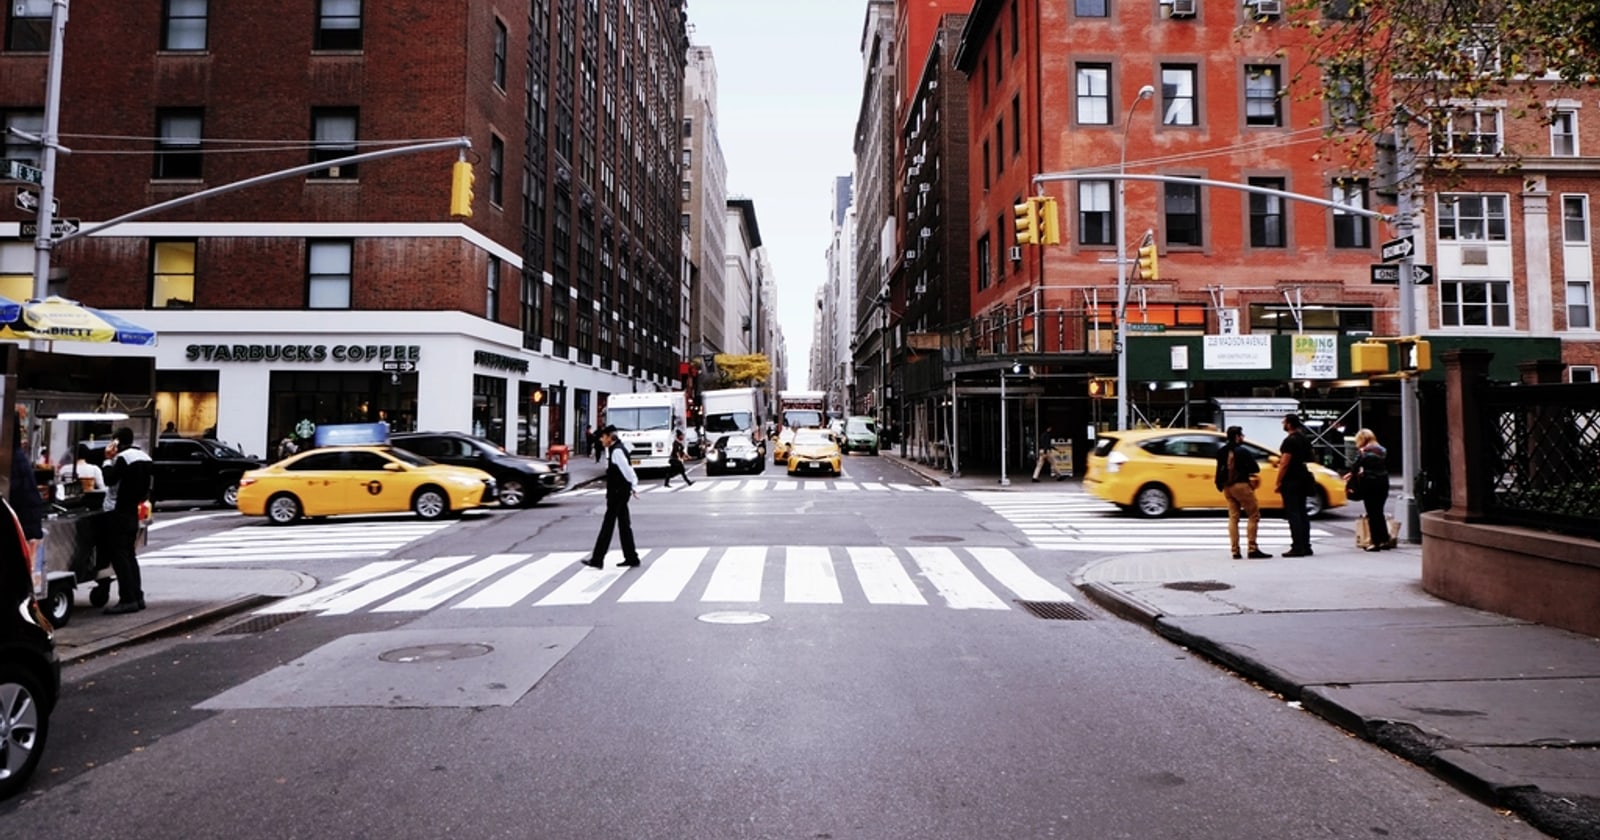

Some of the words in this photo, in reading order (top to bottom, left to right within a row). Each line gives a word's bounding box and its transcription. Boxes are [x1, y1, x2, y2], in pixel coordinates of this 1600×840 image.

[54, 225, 71, 233] WAY
[1380, 270, 1399, 280] ONE
[1219, 336, 1245, 346] MADISON
[1246, 336, 1268, 346] AVENUE
[1295, 338, 1334, 348] SPRING
[186, 344, 328, 362] STARBUCKS
[332, 344, 421, 362] COFFEE
